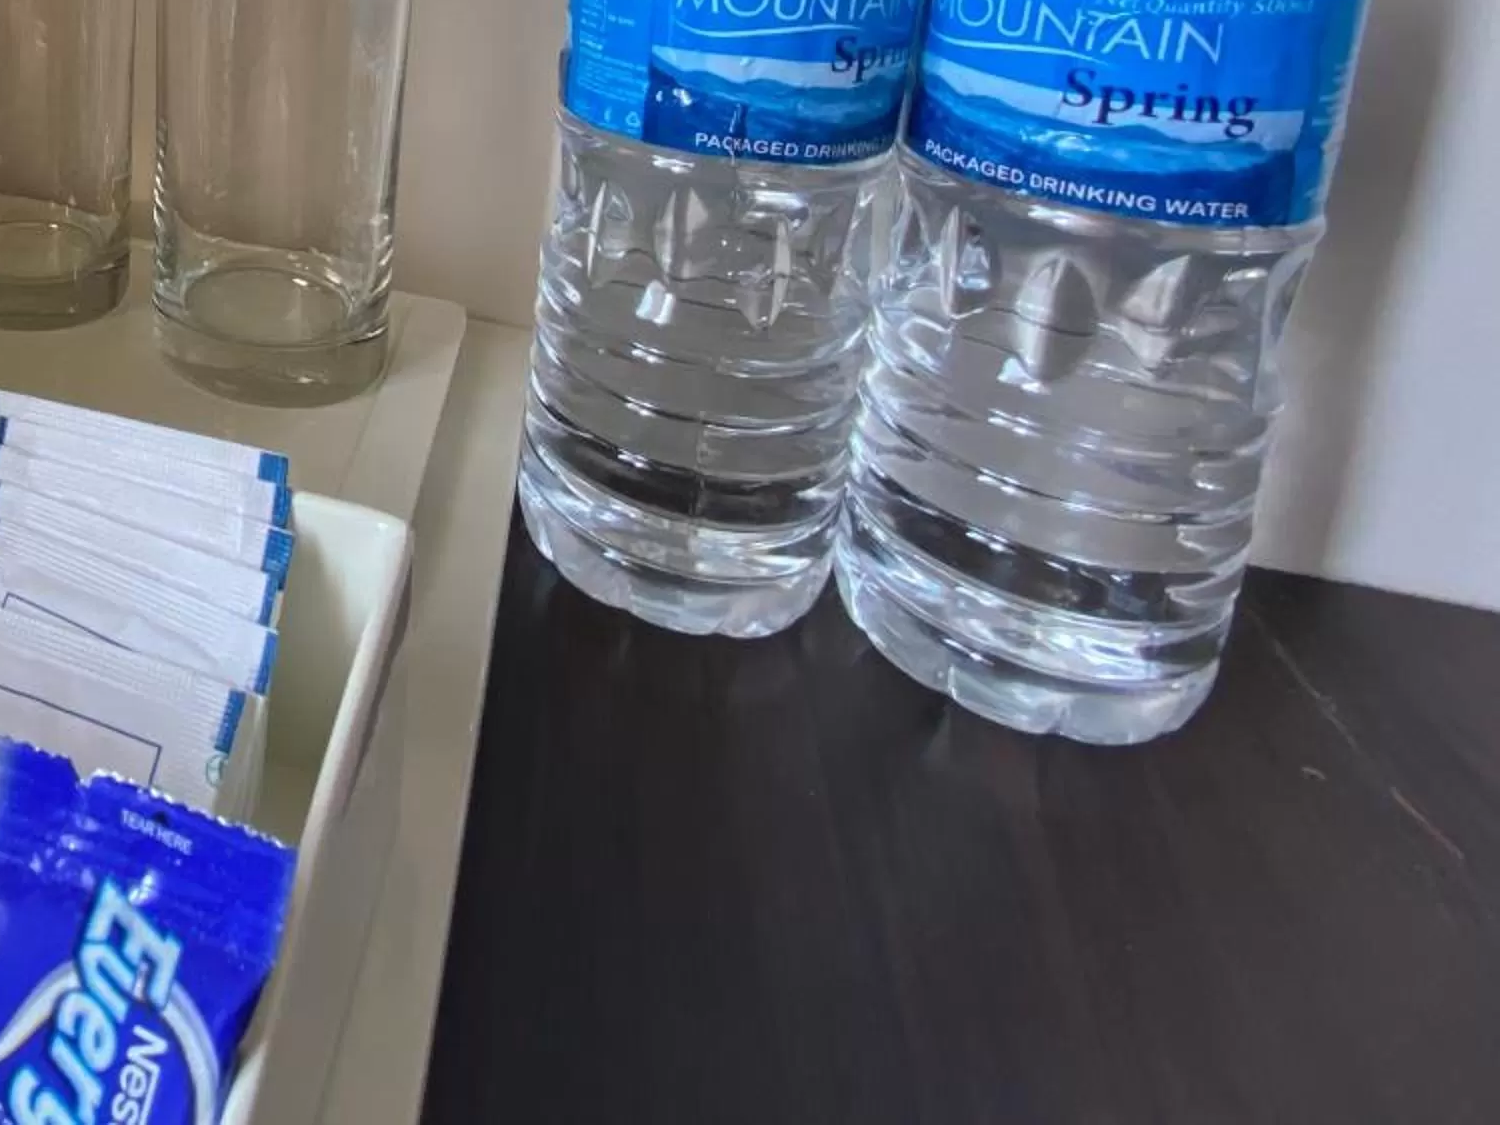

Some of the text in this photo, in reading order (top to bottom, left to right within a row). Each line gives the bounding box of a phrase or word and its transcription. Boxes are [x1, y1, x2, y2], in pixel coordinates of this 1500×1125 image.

[1062, 67, 1260, 139] Spring
[694, 132, 799, 159] PACKAGED
[925, 139, 1025, 184] PACKAGED
[1029, 173, 1157, 212] DRINKING
[1165, 198, 1249, 219] WATER
